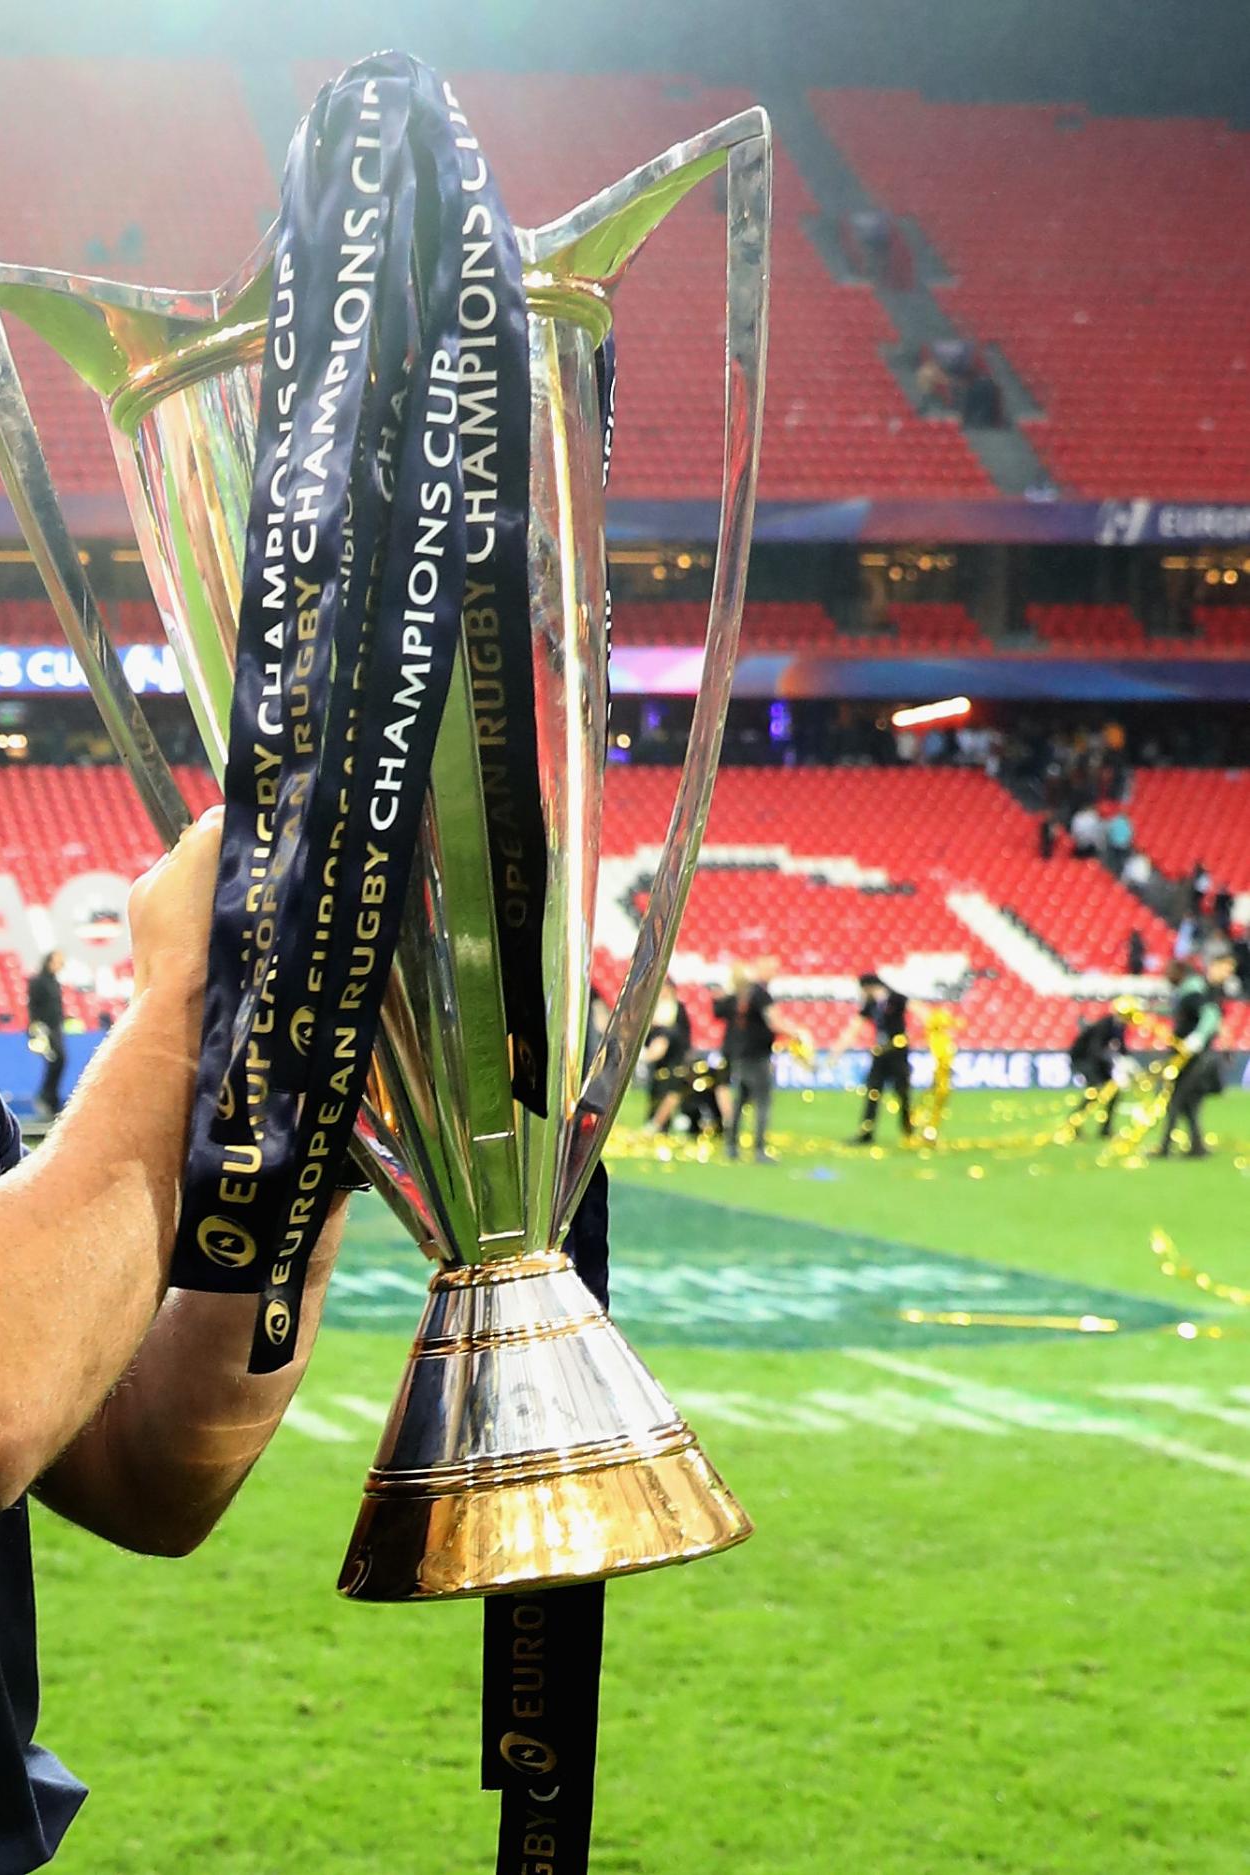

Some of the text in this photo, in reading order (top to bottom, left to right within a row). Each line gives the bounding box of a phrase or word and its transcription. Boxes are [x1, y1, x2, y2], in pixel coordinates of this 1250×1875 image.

[274, 252, 295, 371] CUP
[291, 206, 380, 564] CHAMPIONS
[457, 204, 500, 564] CHAMPIONS
[26, 651, 92, 689] CU
[290, 576, 322, 754] RUGBY
[462, 581, 508, 747] RUGBY
[271, 1026, 357, 1286] EUROPEAN
[338, 840, 390, 1010] RUGBY
[369, 481, 453, 831] CHAMPIONS
[423, 349, 459, 469] CUP
[512, 1604, 546, 1719] EURO
